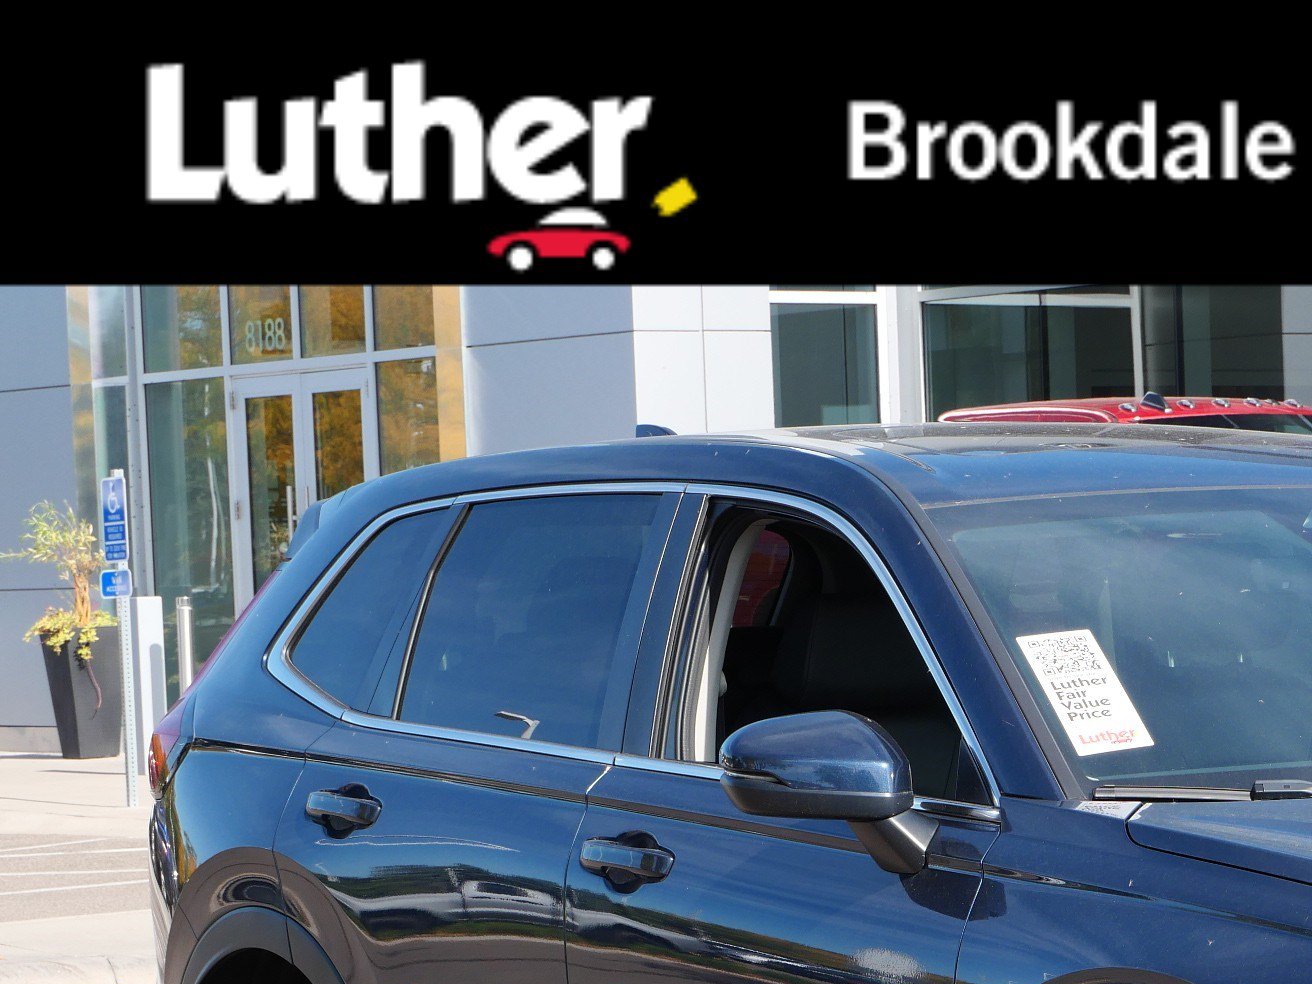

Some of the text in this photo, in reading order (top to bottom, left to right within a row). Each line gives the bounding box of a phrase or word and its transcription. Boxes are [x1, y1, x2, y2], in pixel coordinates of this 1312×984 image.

[245, 317, 286, 352] 8188
[1050, 676, 1107, 691] Luther
[1056, 688, 1087, 701] Fair
[1061, 696, 1112, 711] Value
[1067, 708, 1113, 722] Price
[1078, 729, 1136, 745] Luther
